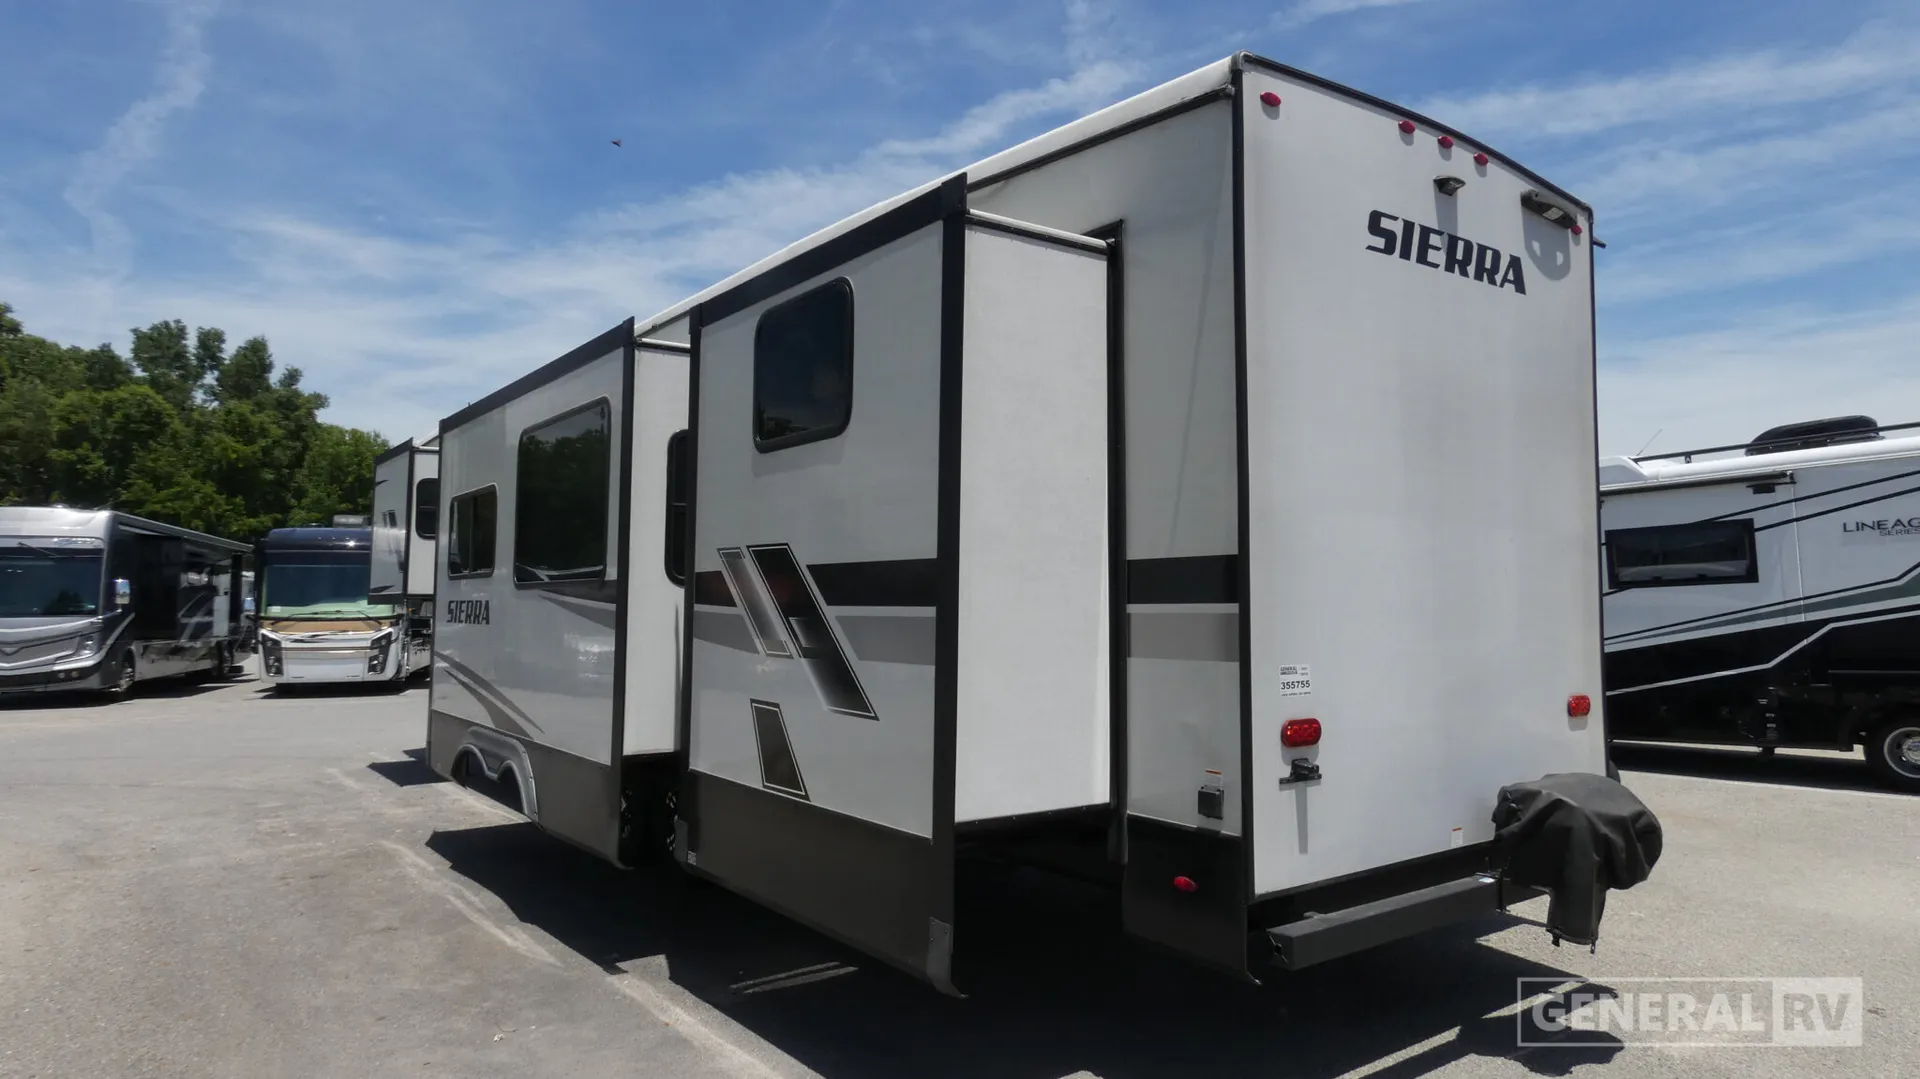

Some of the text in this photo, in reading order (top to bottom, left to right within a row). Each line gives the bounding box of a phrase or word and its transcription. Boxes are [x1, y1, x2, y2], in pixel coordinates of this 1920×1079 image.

[1365, 209, 1527, 296] SIERRA
[446, 600, 490, 625] SIERRA
[1280, 680, 1311, 690] 355755
